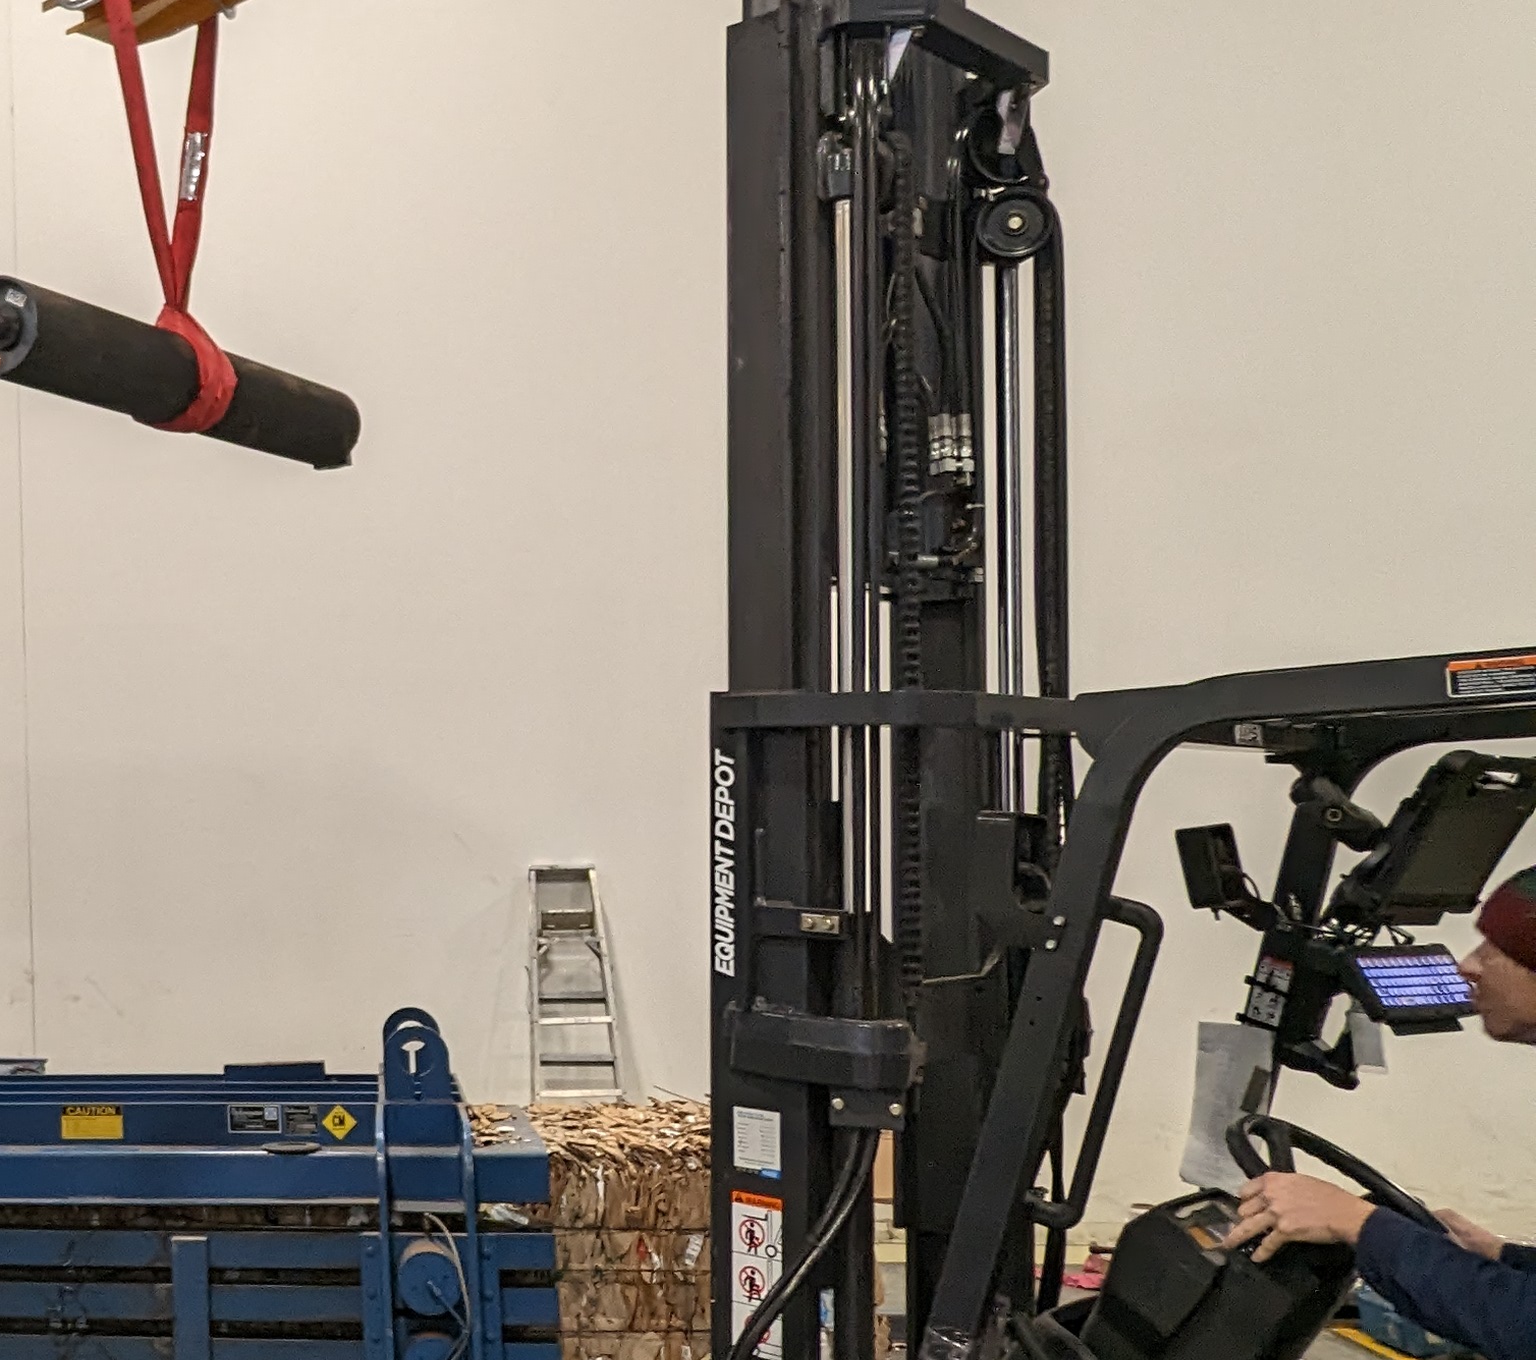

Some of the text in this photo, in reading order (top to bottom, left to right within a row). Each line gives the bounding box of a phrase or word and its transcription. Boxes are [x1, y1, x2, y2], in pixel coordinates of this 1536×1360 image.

[714, 748, 736, 977] EQUIPMENT DEPOT
[66, 1106, 116, 1116] CAUTION
